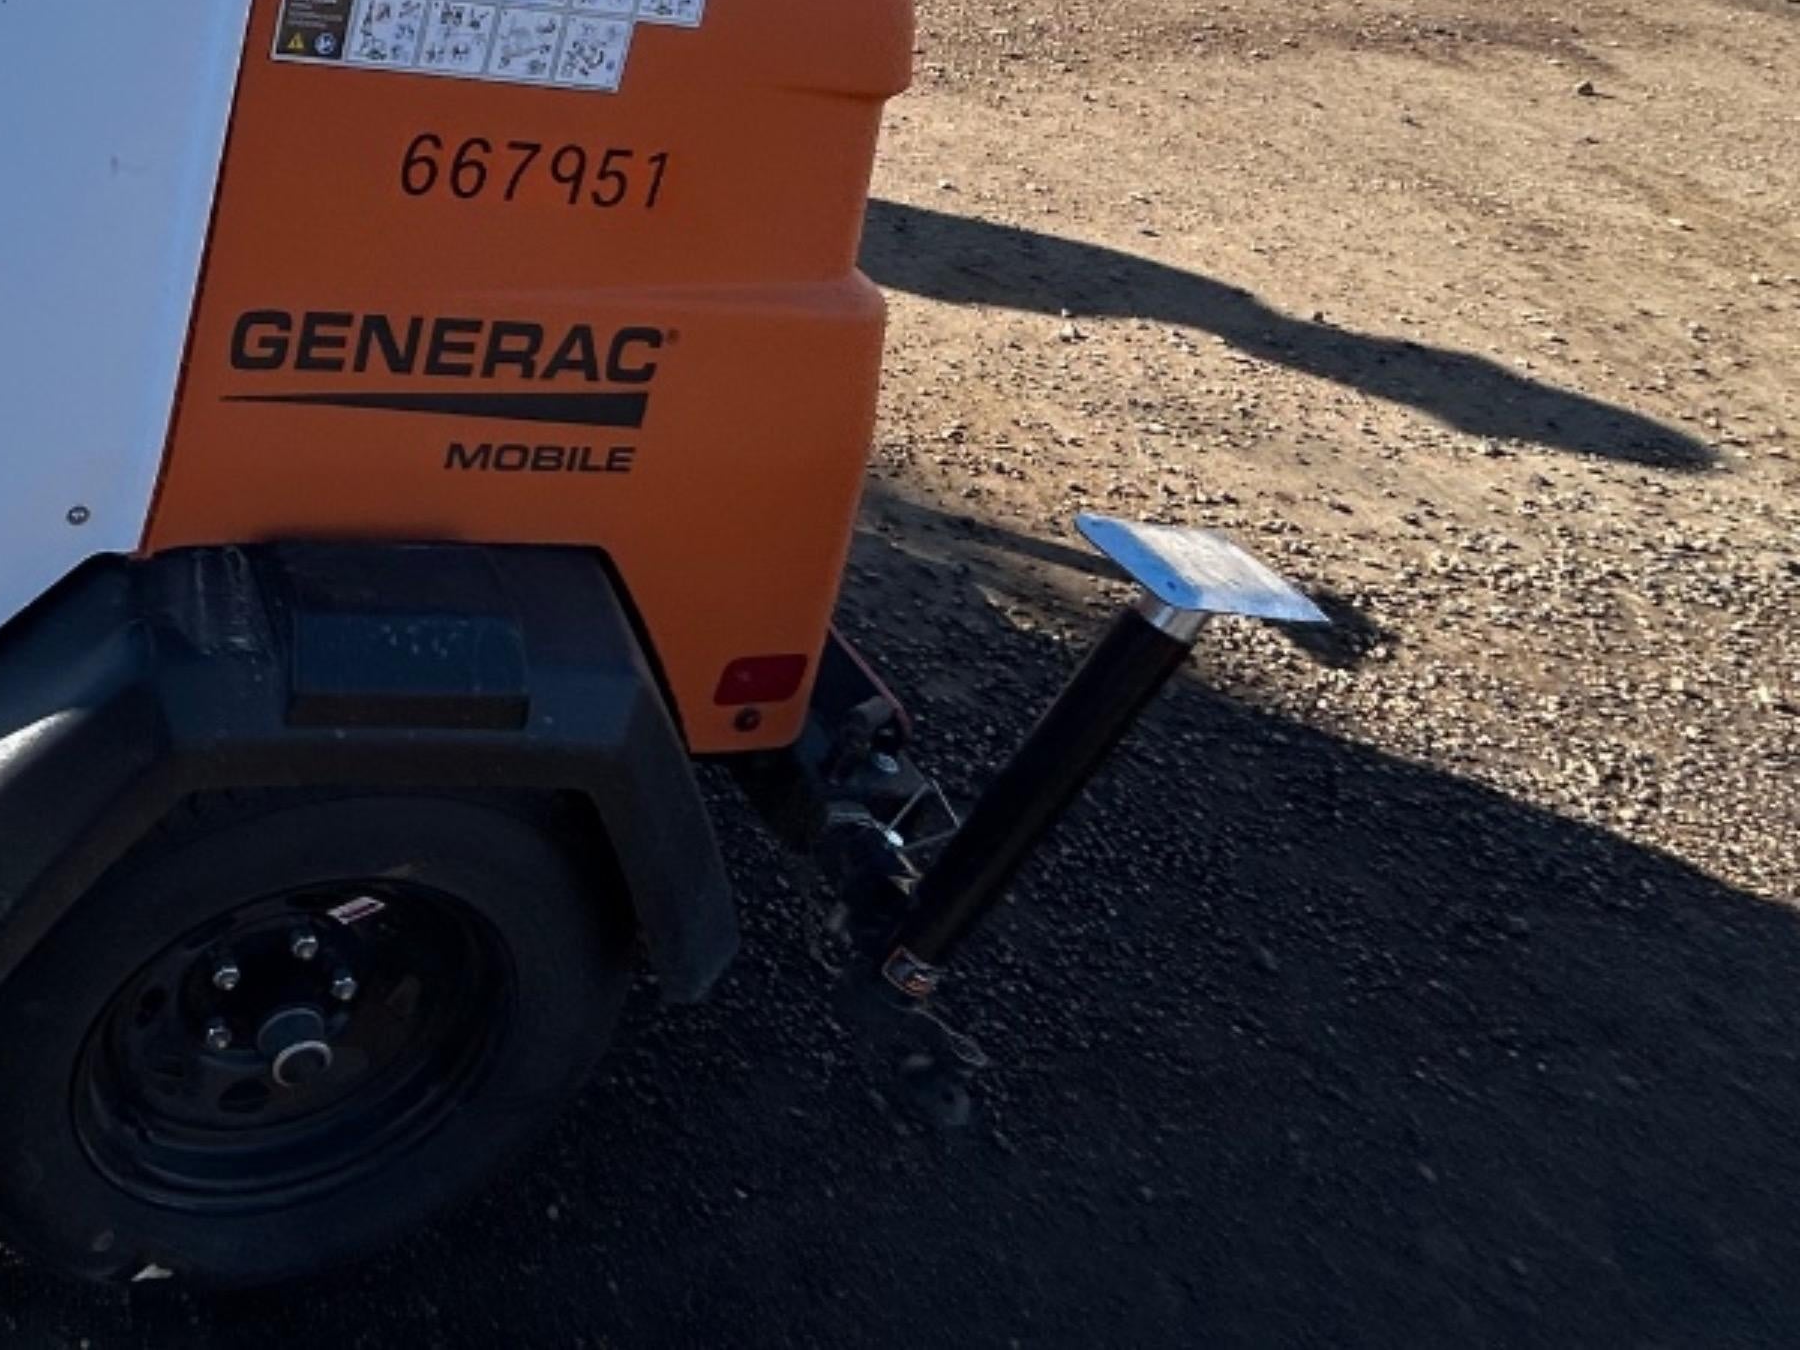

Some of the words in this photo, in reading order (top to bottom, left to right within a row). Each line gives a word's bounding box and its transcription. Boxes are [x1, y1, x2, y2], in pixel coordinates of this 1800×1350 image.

[400, 131, 669, 209] 667951
[229, 308, 664, 383] GENERAC
[442, 442, 638, 473] MOBILE
